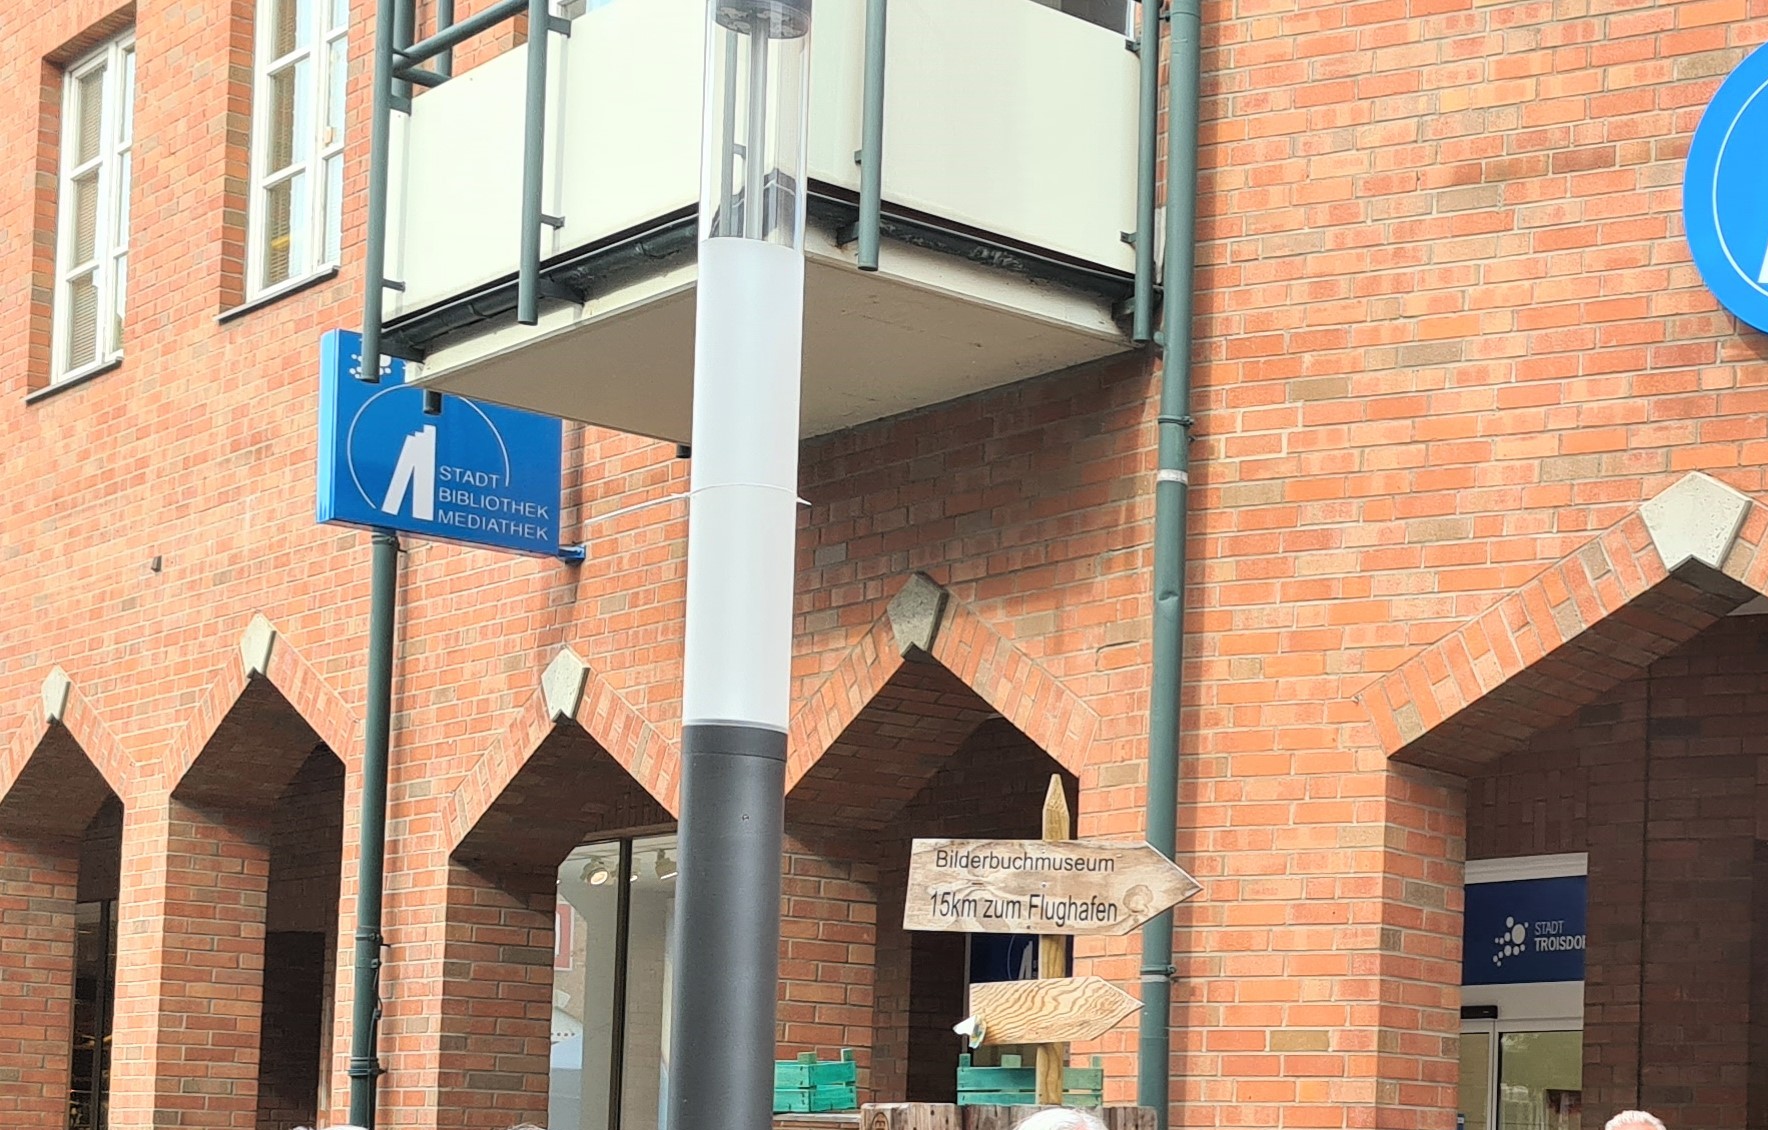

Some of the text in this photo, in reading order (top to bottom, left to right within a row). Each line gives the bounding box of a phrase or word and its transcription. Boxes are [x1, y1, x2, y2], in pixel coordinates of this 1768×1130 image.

[439, 465, 500, 489] STADT
[438, 487, 549, 520] BIBLIOTHEK
[437, 509, 549, 541] MEDIATHEK
[935, 850, 1115, 872] Bilderbuchmuseum
[930, 890, 1118, 927] 15km zum Flughafen
[1534, 920, 1565, 935] STADT
[1534, 935, 1586, 952] TROISDO
